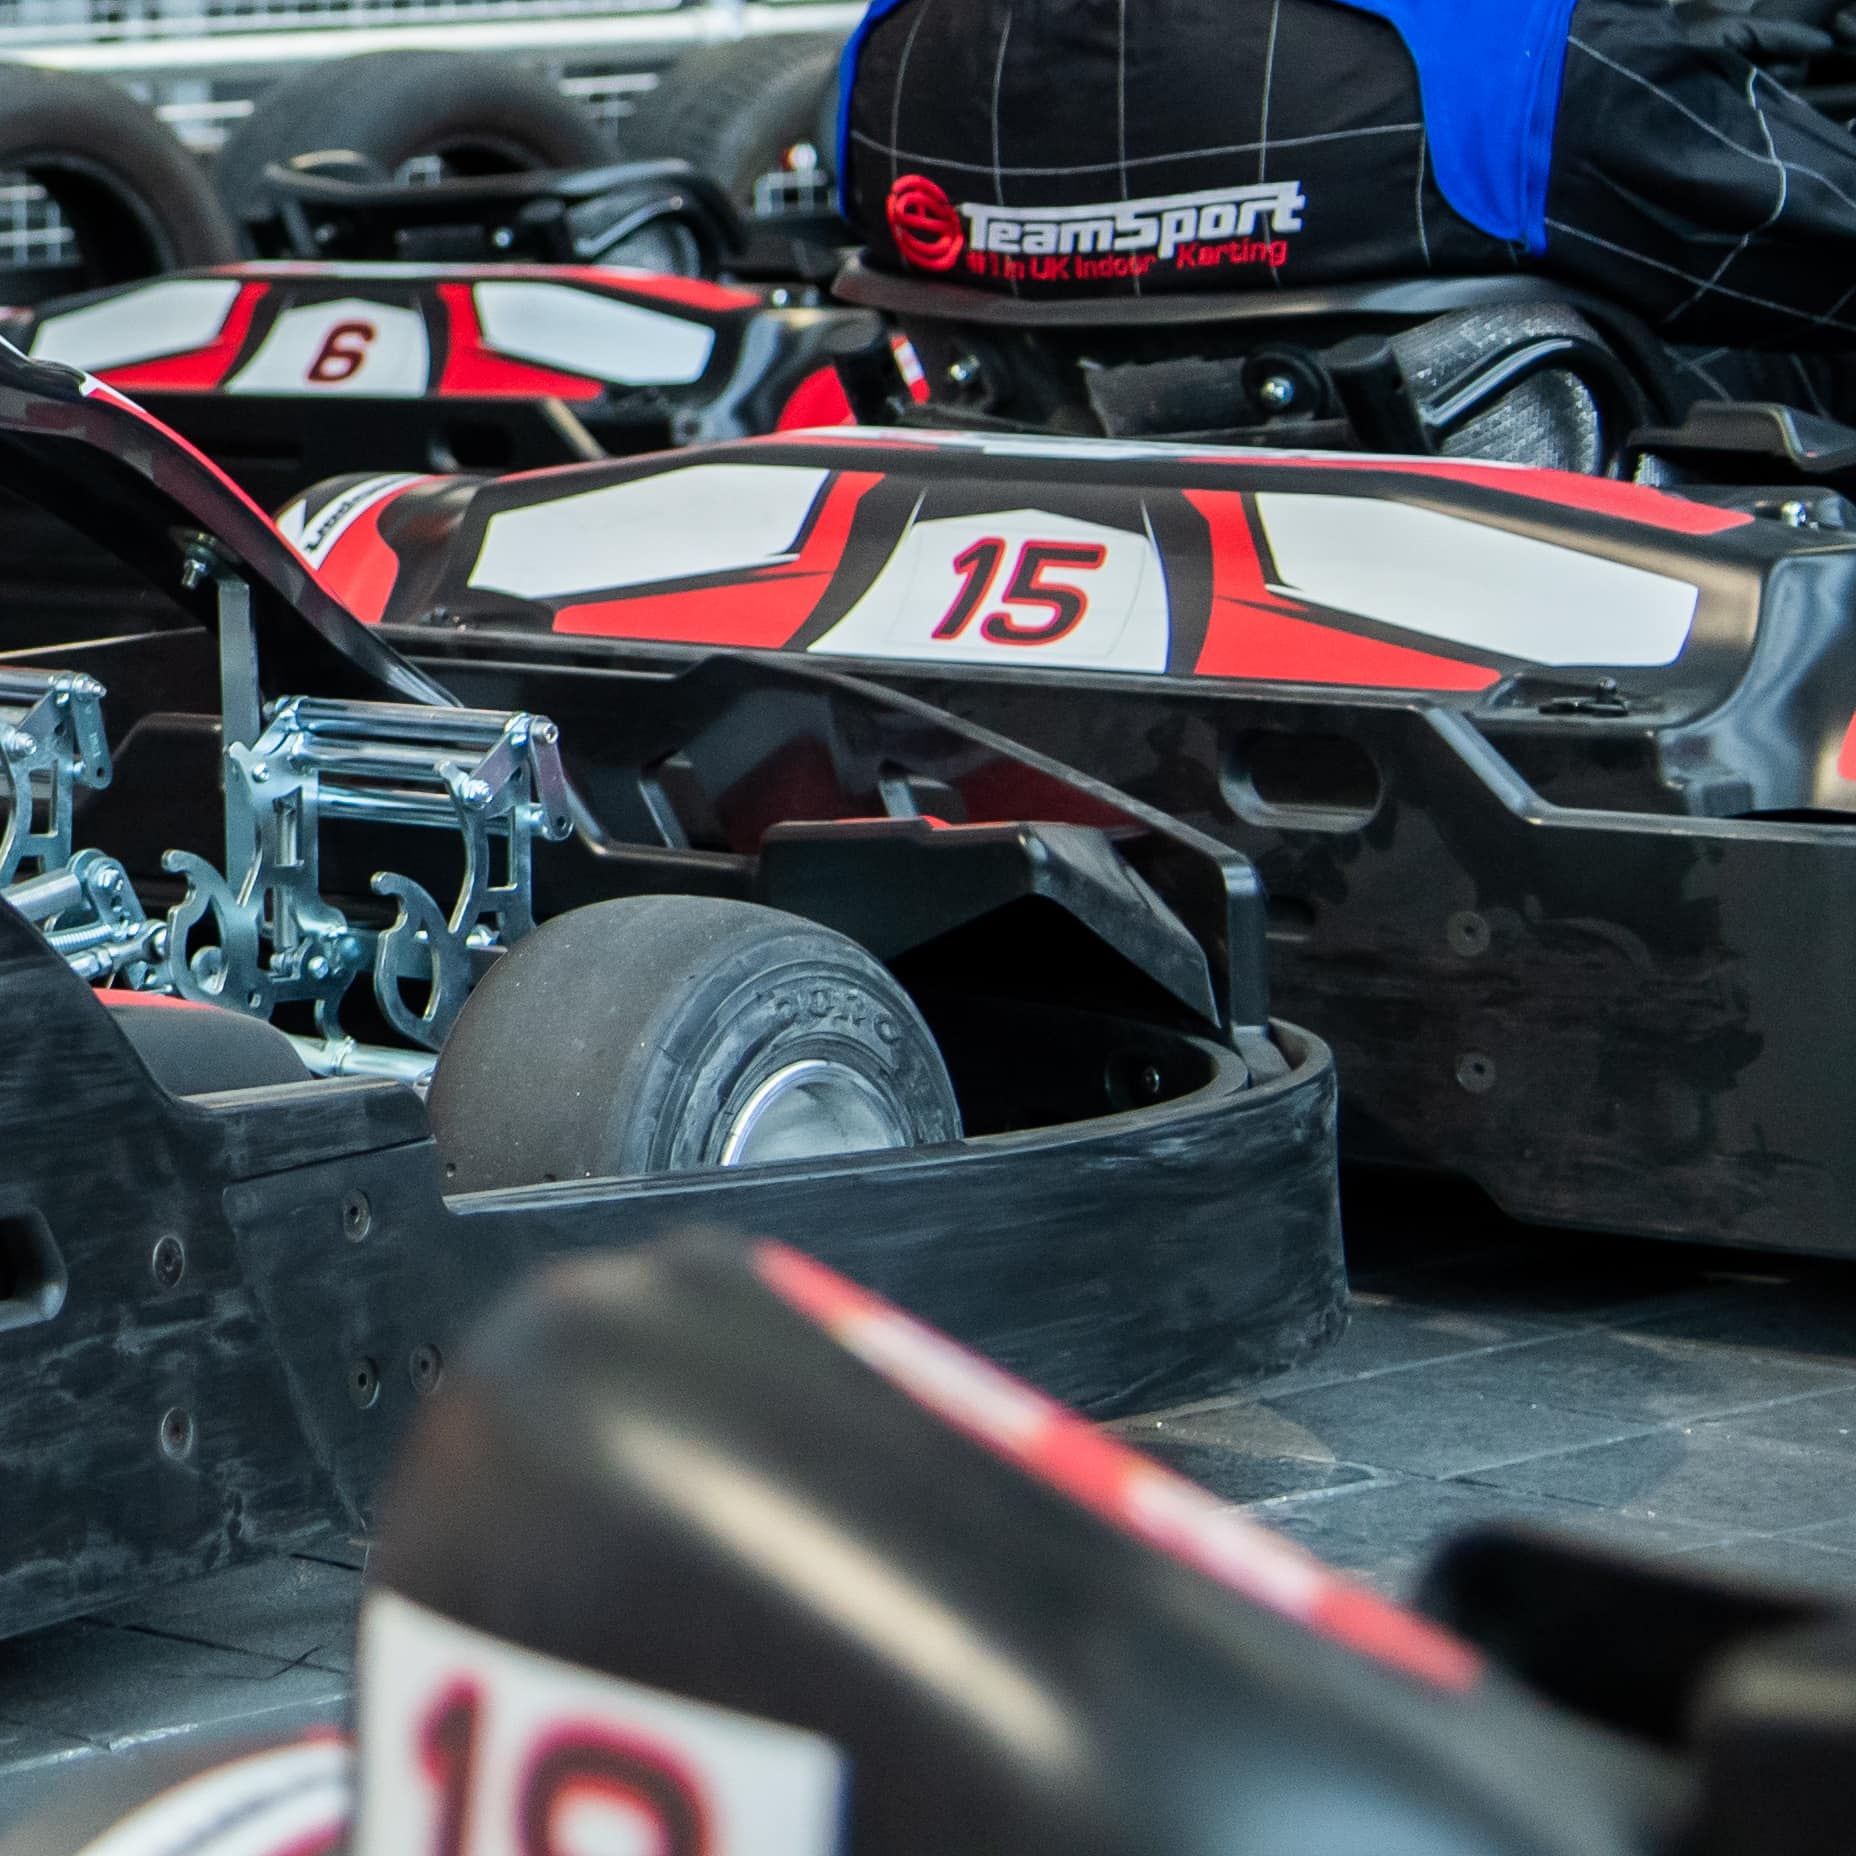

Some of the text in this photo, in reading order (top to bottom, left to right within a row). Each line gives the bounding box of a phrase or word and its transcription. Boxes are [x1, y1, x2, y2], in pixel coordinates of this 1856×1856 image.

[961, 181, 1305, 259] TeamSport
[1030, 255, 1070, 282] UK
[1175, 237, 1289, 271] Karting
[305, 319, 377, 383] 6
[930, 535, 1108, 648] 15
